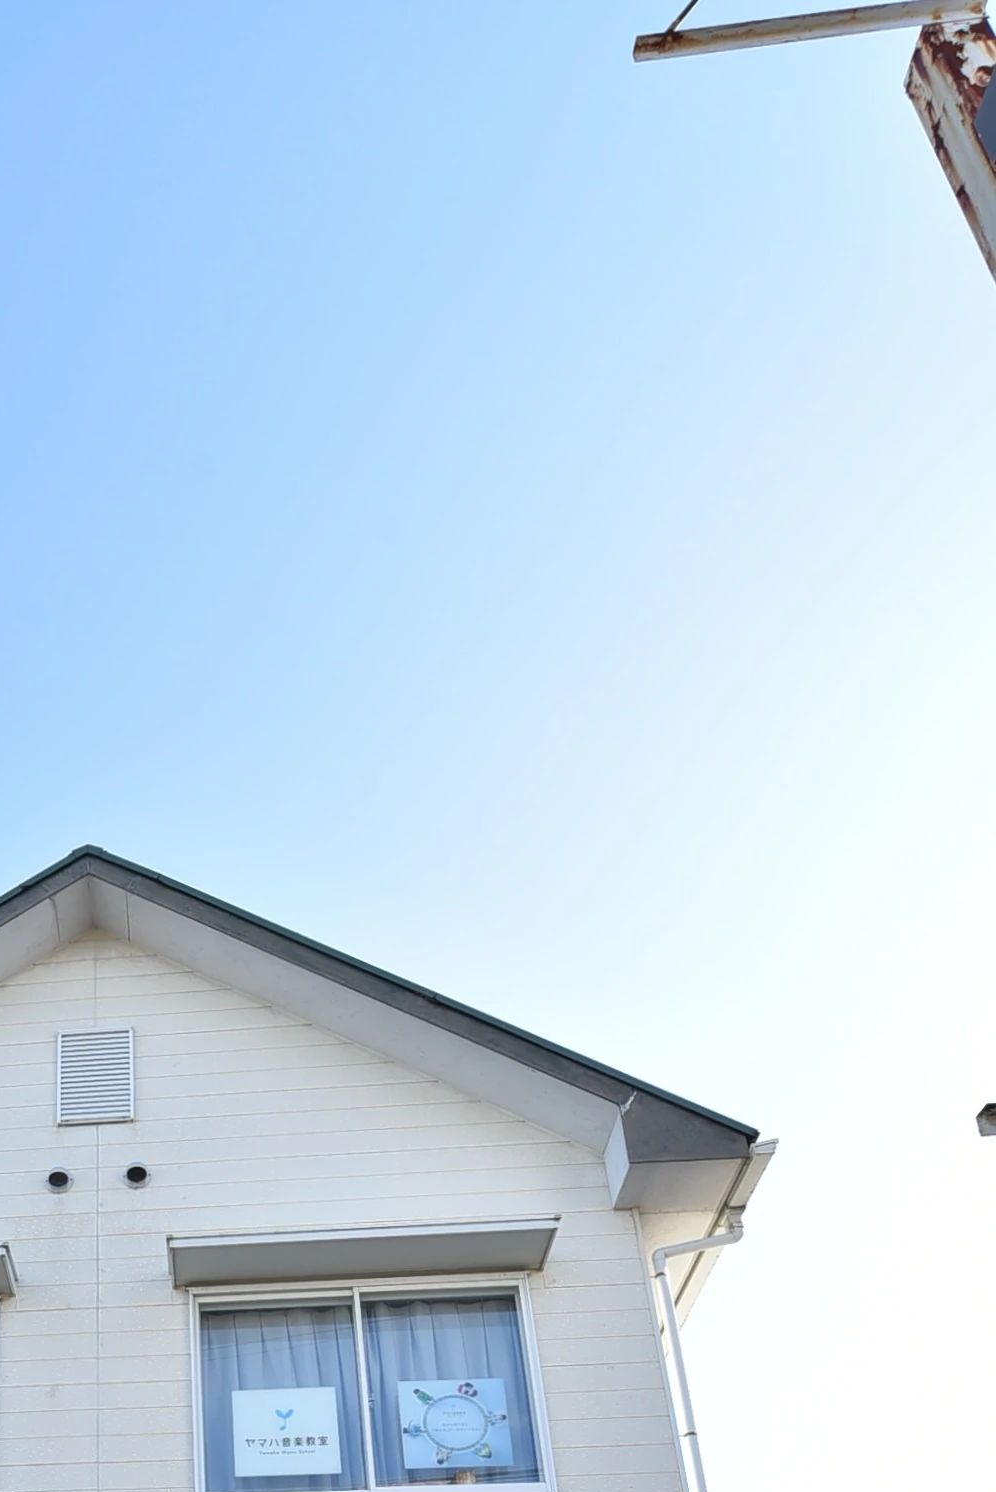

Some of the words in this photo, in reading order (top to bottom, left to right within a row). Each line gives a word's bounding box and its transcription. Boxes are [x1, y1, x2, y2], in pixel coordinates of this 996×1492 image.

[245, 1436, 330, 1448] ヤマハ音楽教室
